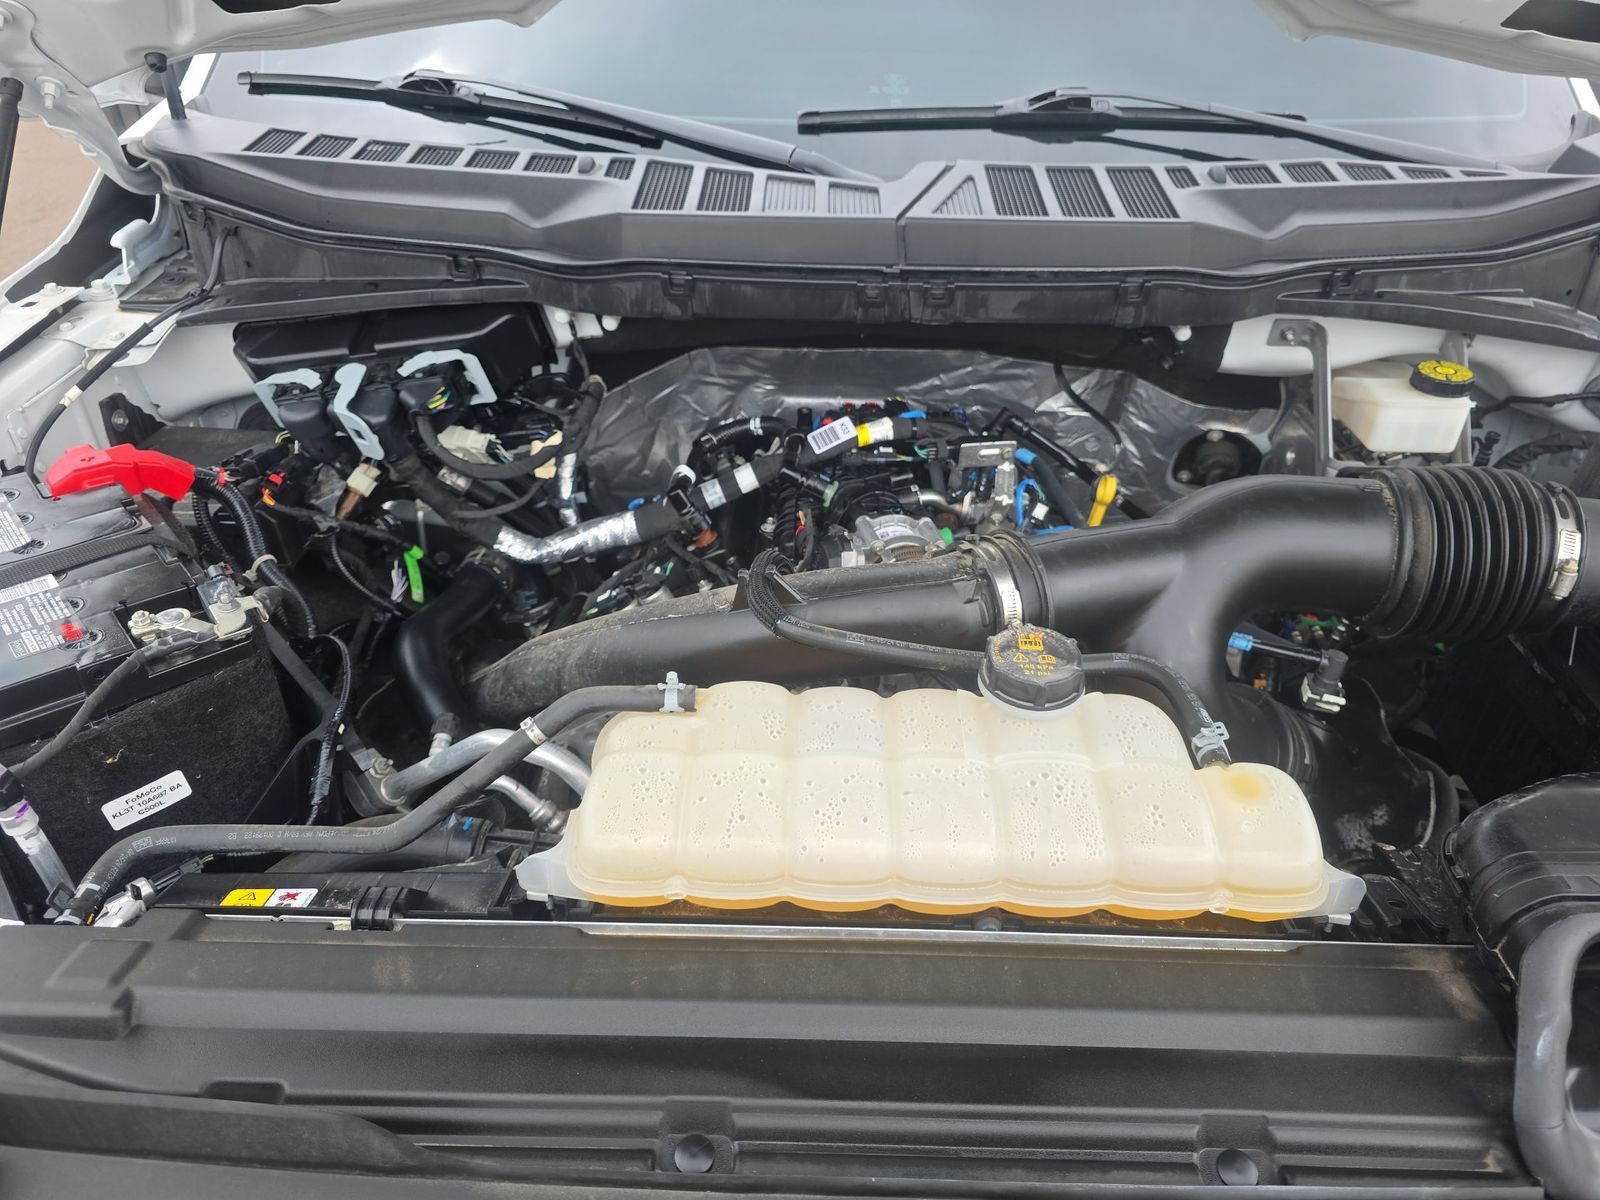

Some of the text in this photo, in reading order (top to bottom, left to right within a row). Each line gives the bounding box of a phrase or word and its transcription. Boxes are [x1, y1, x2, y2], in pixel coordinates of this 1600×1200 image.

[111, 782, 183, 820] KL3T 10A687 BA
[125, 785, 163, 805] FoMoCo
[137, 800, 166, 816] C500L
